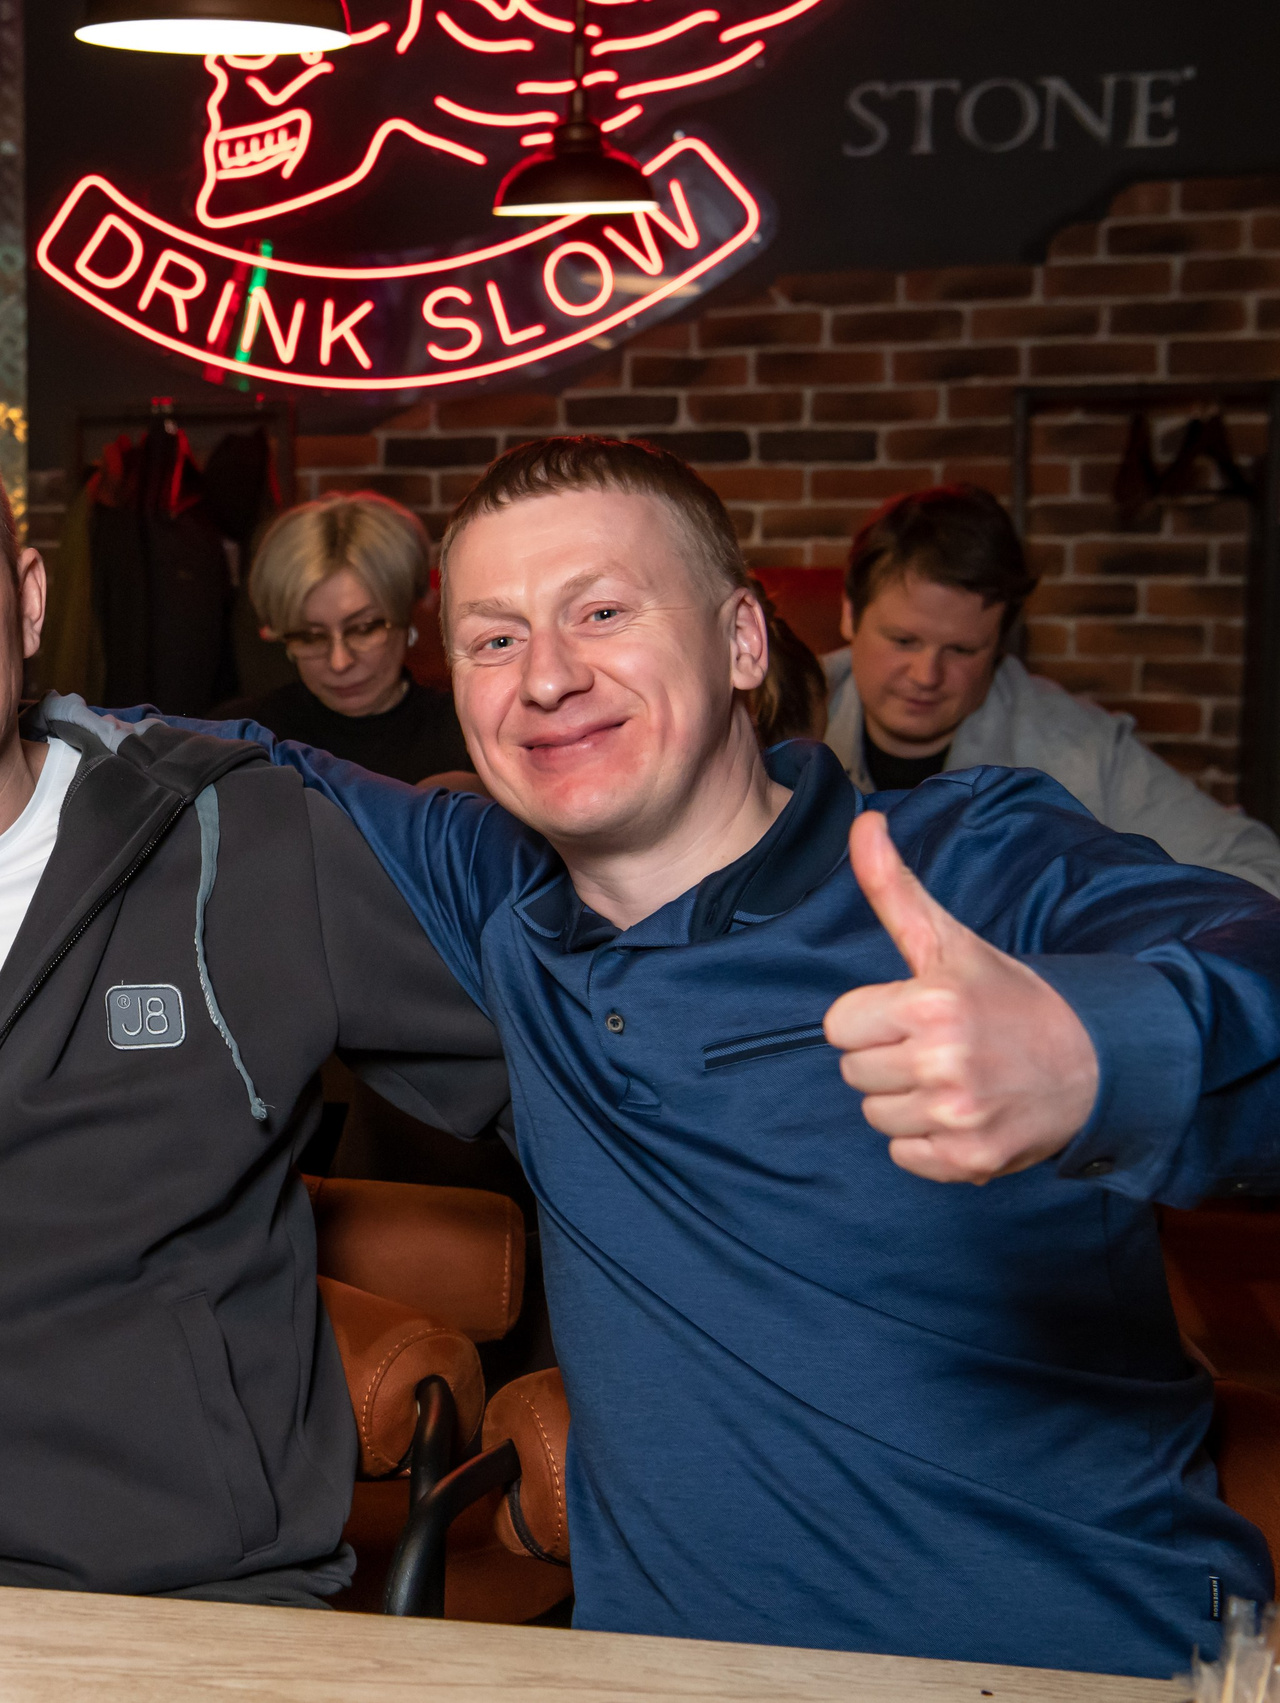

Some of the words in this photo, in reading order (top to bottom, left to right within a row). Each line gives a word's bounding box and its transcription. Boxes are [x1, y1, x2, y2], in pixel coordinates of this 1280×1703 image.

[841, 70, 1182, 157] STONE
[75, 213, 374, 369] DRINK
[421, 179, 701, 361] SLOW
